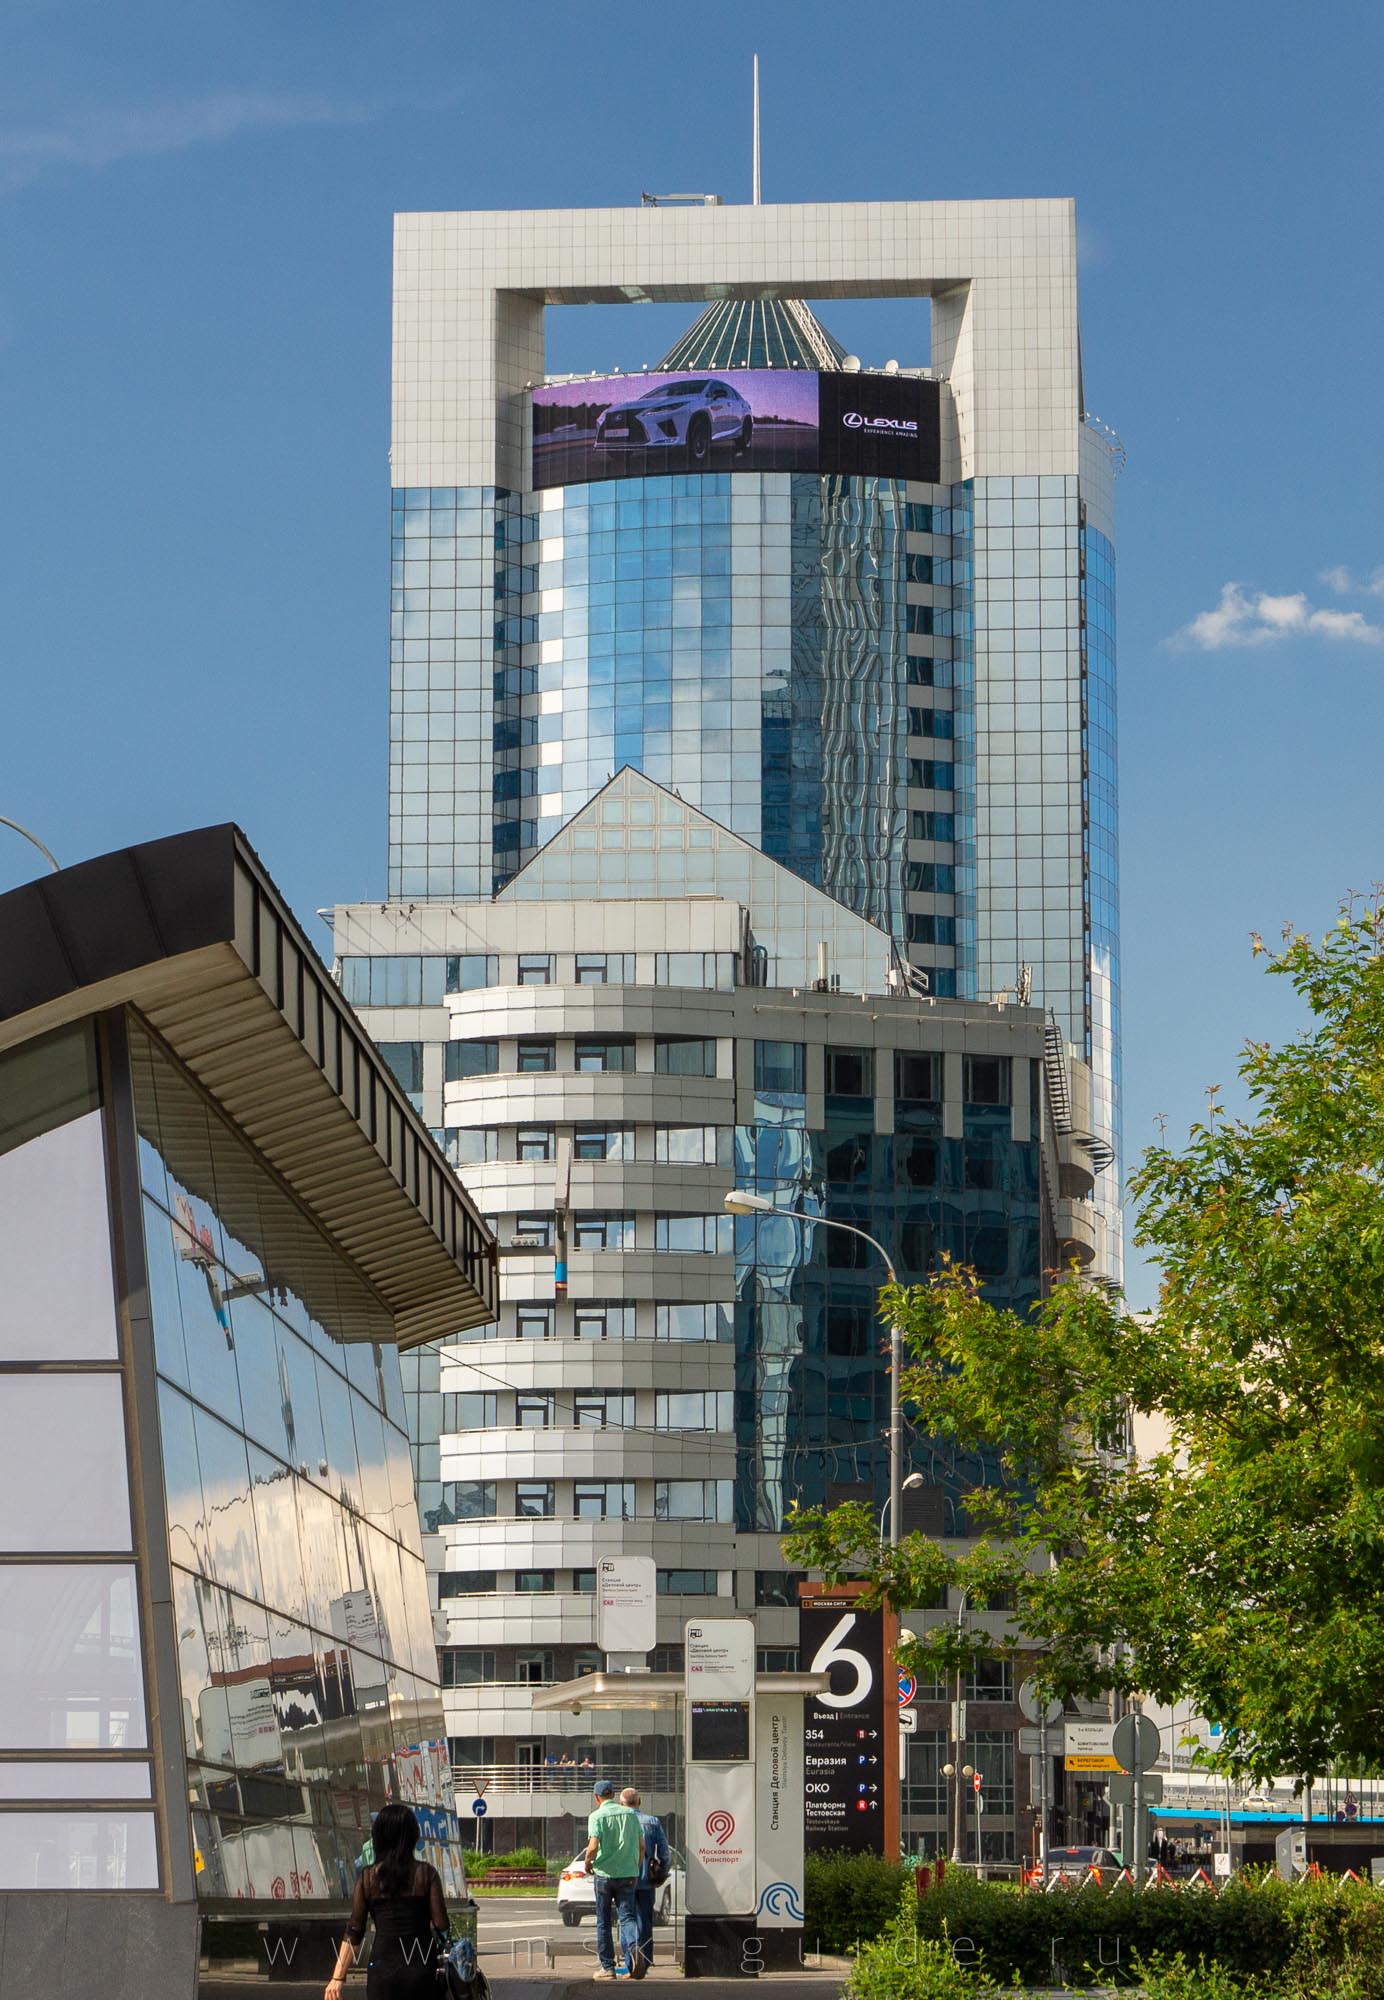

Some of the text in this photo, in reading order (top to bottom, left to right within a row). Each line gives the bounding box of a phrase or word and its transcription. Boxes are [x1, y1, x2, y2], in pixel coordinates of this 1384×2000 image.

[864, 417, 918, 430] LEXUS
[864, 428, 918, 439] EXPERIENCE AMAZING
[810, 1613, 873, 1708] 6
[813, 1712, 834, 1720] Въезд
[805, 1729, 824, 1739] 354
[805, 1755, 847, 1768] Евразия
[770, 1715, 780, 1831] Станция Деловой центр
[805, 1767, 835, 1775] Eurasia
[805, 1783, 830, 1793] ОКО
[805, 1801, 846, 1810] Платформа
[703, 1856, 739, 1864] Транспорт
